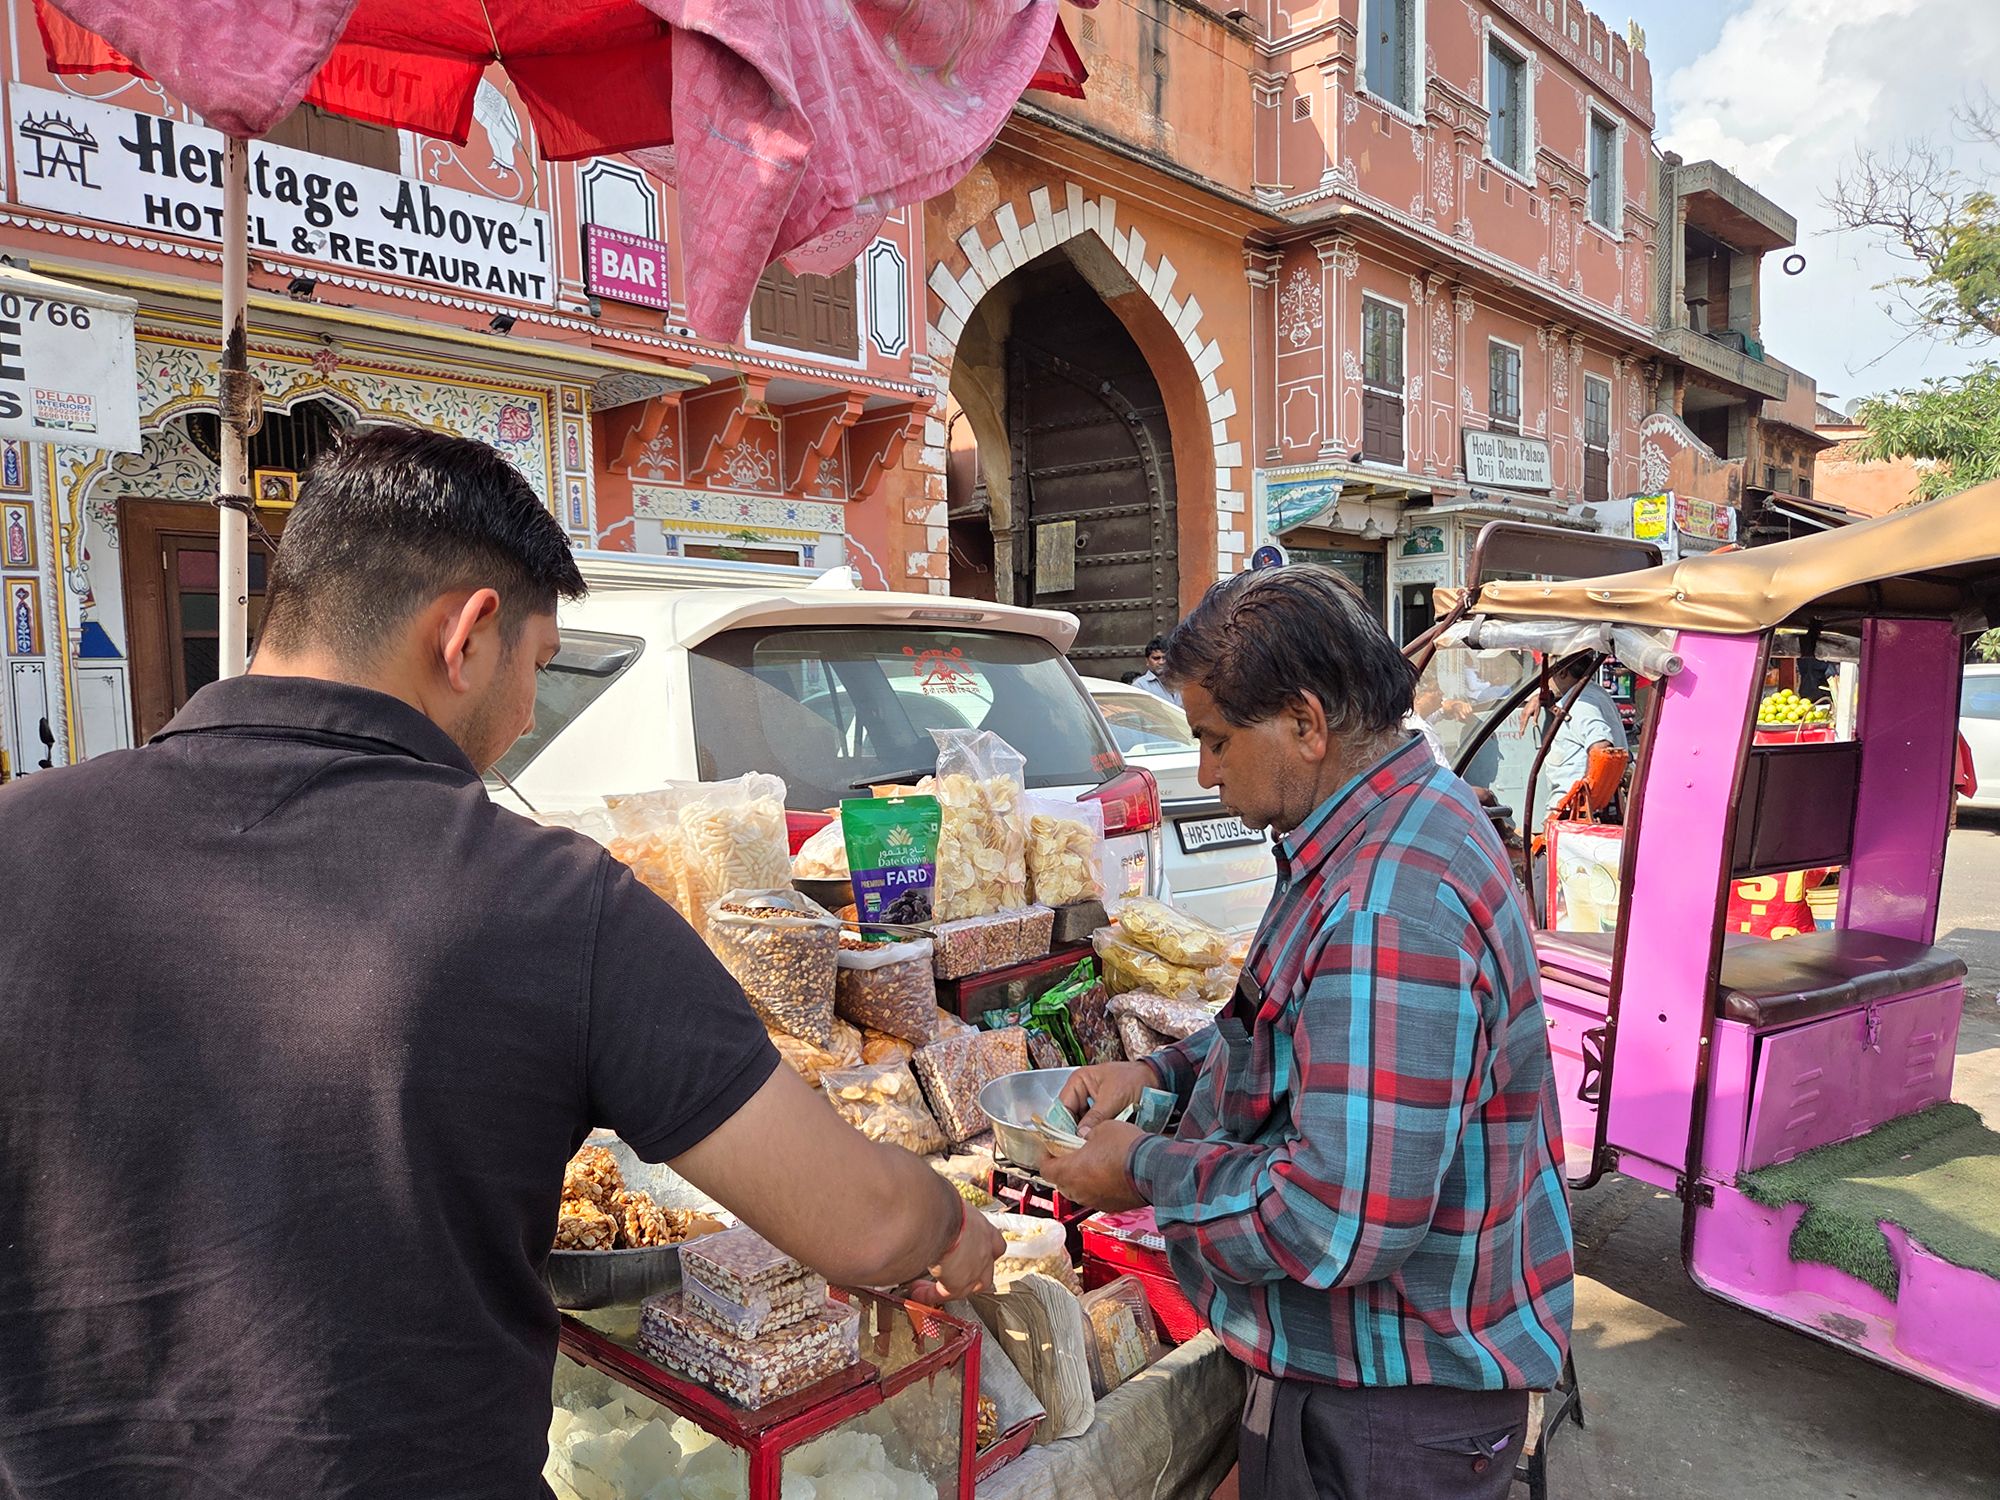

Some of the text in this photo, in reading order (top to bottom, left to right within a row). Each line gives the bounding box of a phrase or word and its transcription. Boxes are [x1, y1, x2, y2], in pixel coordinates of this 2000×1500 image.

[118, 113, 359, 227] Hertage
[144, 194, 546, 300] HOTL & RESTAURANT
[601, 247, 657, 288] BAR
[0, 293, 91, 330] 0766
[35, 389, 92, 405] DELADI
[36, 399, 91, 412] INTERIORS
[1472, 435, 1545, 463] Hotel Dhan Palace
[1477, 457, 1544, 482] Brij Restaurant
[877, 857, 900, 868] Date
[886, 867, 928, 887] FARD
